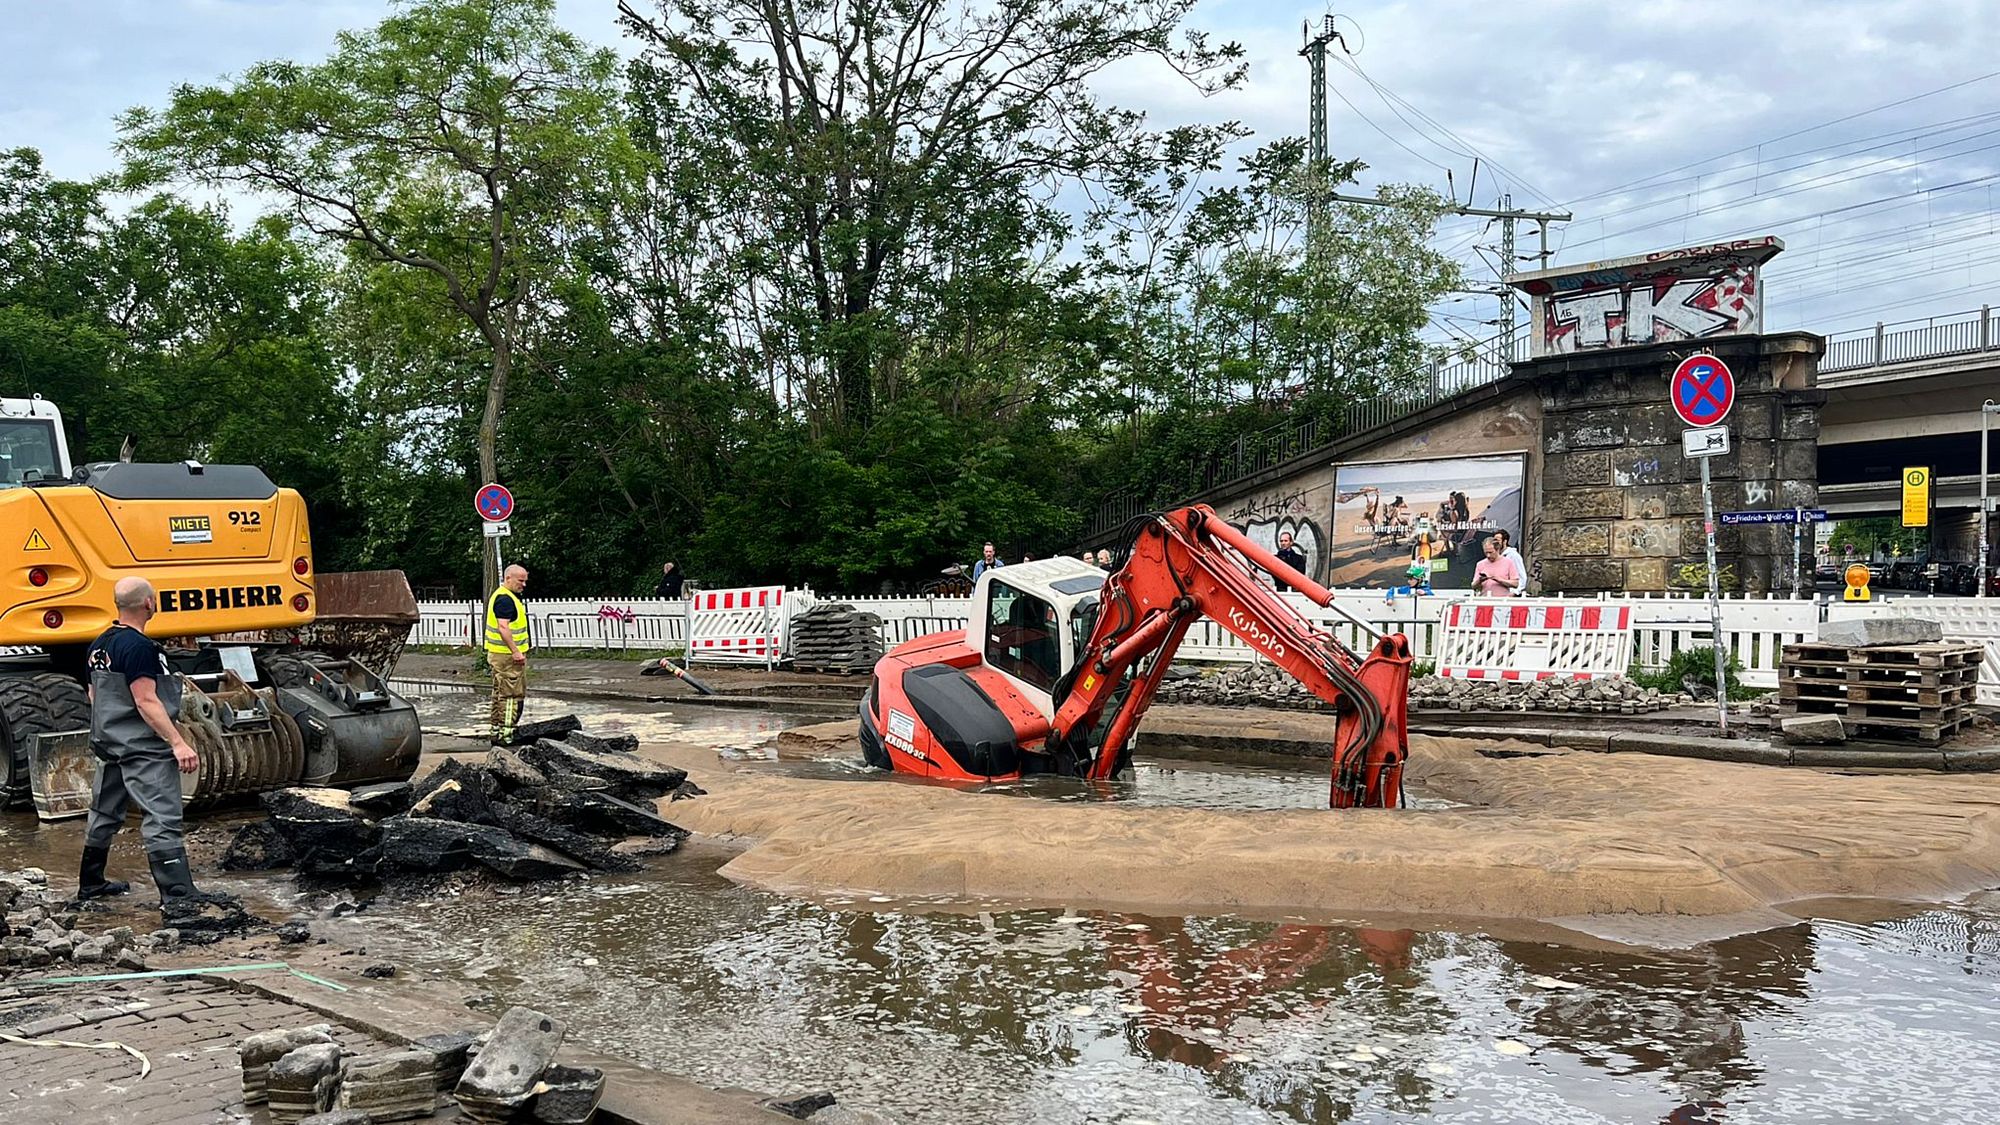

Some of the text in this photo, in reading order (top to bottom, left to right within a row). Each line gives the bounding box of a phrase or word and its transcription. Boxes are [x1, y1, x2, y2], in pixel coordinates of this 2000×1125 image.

[171, 517, 210, 531] MIETE
[228, 511, 261, 525] 912
[1354, 524, 1373, 533] Unser
[1436, 521, 1456, 530] Unser
[155, 585, 283, 613] EBHERR
[1228, 606, 1286, 658] Kubota
